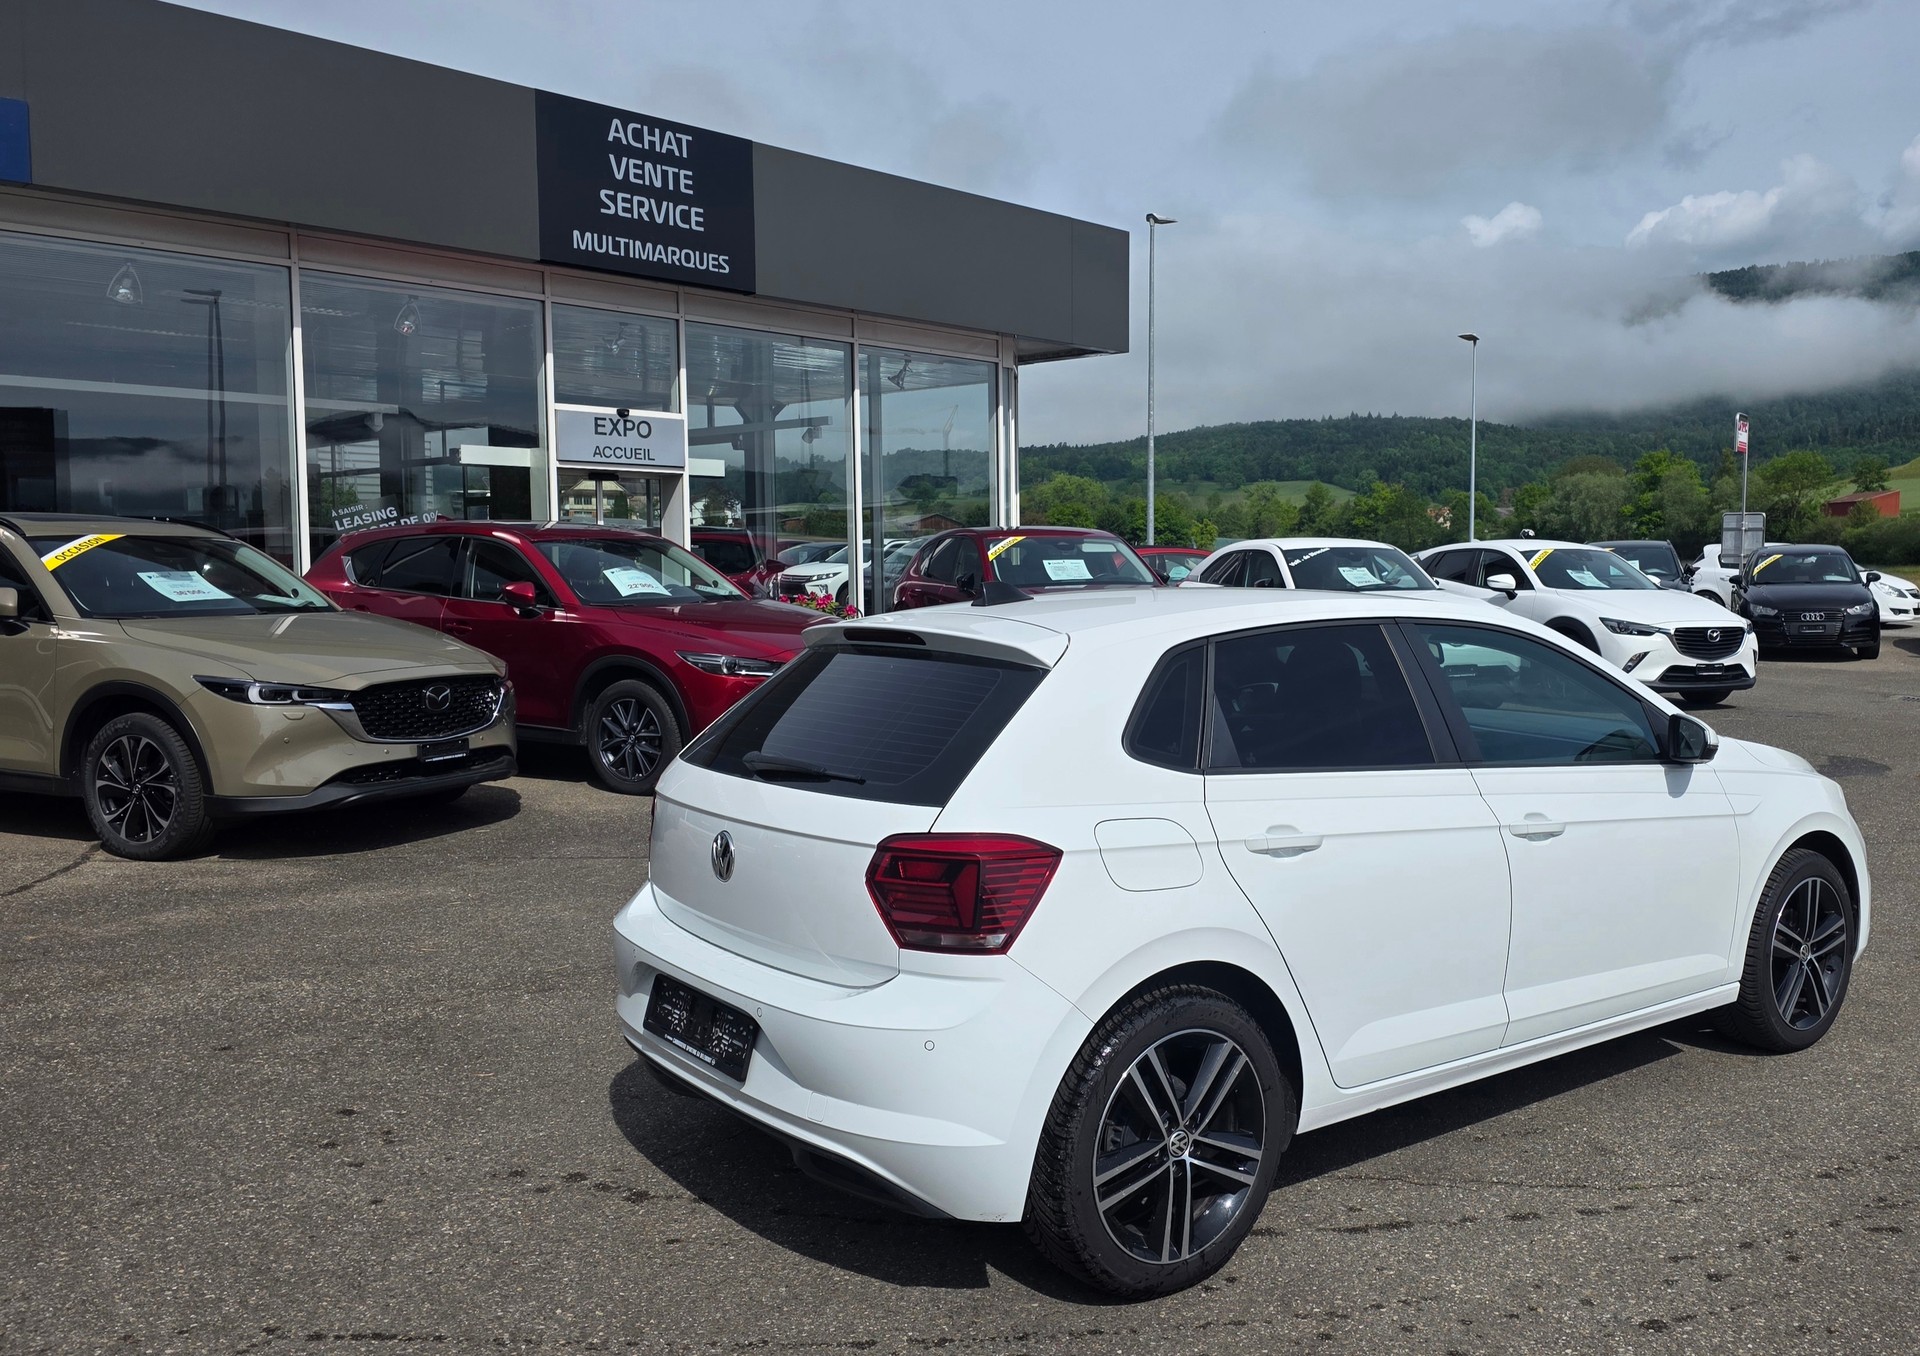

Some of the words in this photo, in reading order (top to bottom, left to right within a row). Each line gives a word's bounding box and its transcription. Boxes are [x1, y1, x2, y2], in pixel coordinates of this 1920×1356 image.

[607, 118, 692, 159] ACHAT
[608, 153, 694, 195] VENTE
[599, 189, 705, 232] SERVICE
[572, 229, 730, 274] MULTIMARQUES
[593, 416, 652, 439] EXPO
[593, 445, 656, 461] ACCUEIL
[334, 506, 398, 531] LEASING
[338, 504, 364, 516] SAISIR
[54, 535, 106, 561] OCCASION
